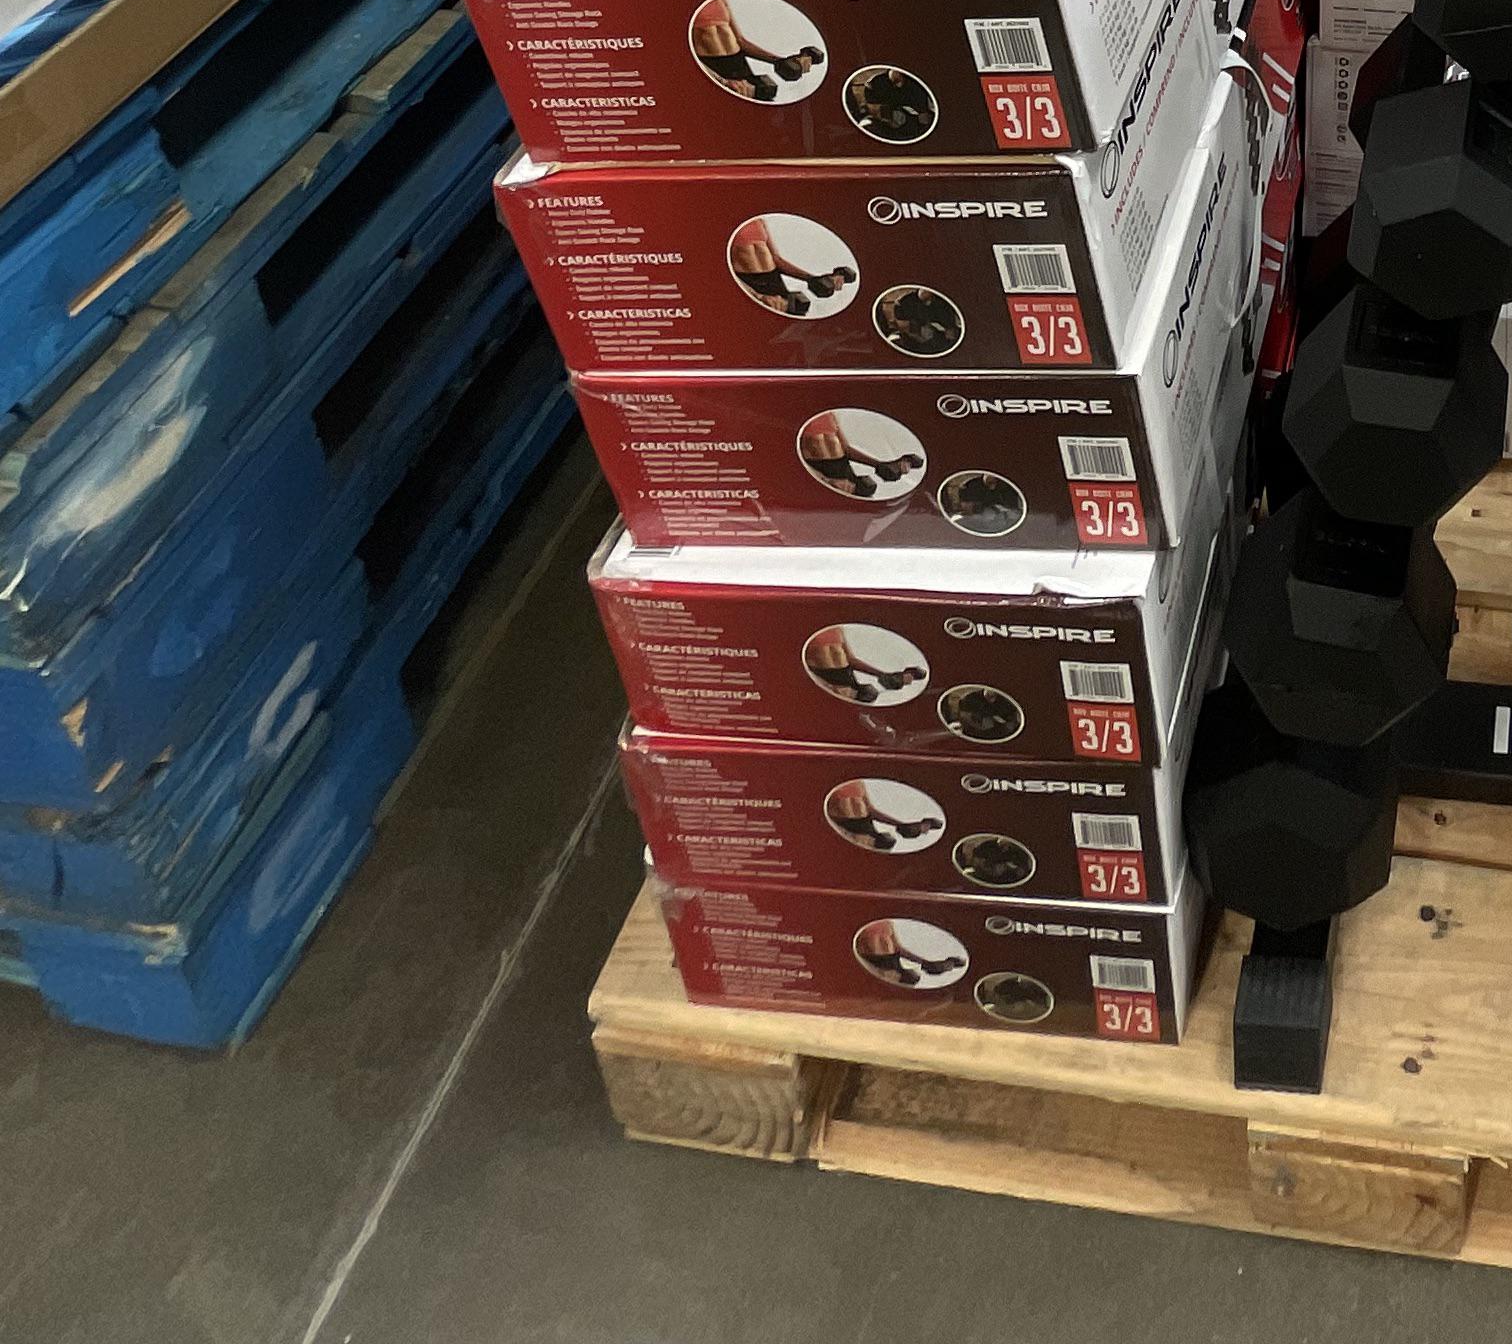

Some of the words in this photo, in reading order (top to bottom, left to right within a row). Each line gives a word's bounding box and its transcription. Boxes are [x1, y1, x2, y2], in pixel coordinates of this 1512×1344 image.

[517, 37, 644, 51] CARACTÉRISTIQUES
[541, 97, 656, 108] CARACTERISTICAS
[996, 96, 1062, 141] 3/3
[537, 196, 603, 209] FEATURES
[901, 200, 1048, 219] INSPIRE
[558, 252, 683, 266] CARACTÉRISTIQUES
[578, 308, 692, 320] CARACTERISTICAS
[1020, 315, 1083, 355] 3/3
[970, 399, 1113, 414] INSPIRE
[631, 441, 753, 452] CARACTÉRISTIQUES
[649, 490, 760, 500] CARACTERISTICAS
[1081, 500, 1140, 538] 3/3
[977, 623, 1116, 644] INSPIRE
[1077, 718, 1134, 754] 3/3
[991, 779, 1127, 797] INSPIRE
[1088, 864, 1140, 895] 3/3
[1013, 922, 1142, 944] INSPIRE
[1103, 1003, 1153, 1034] 3/3
